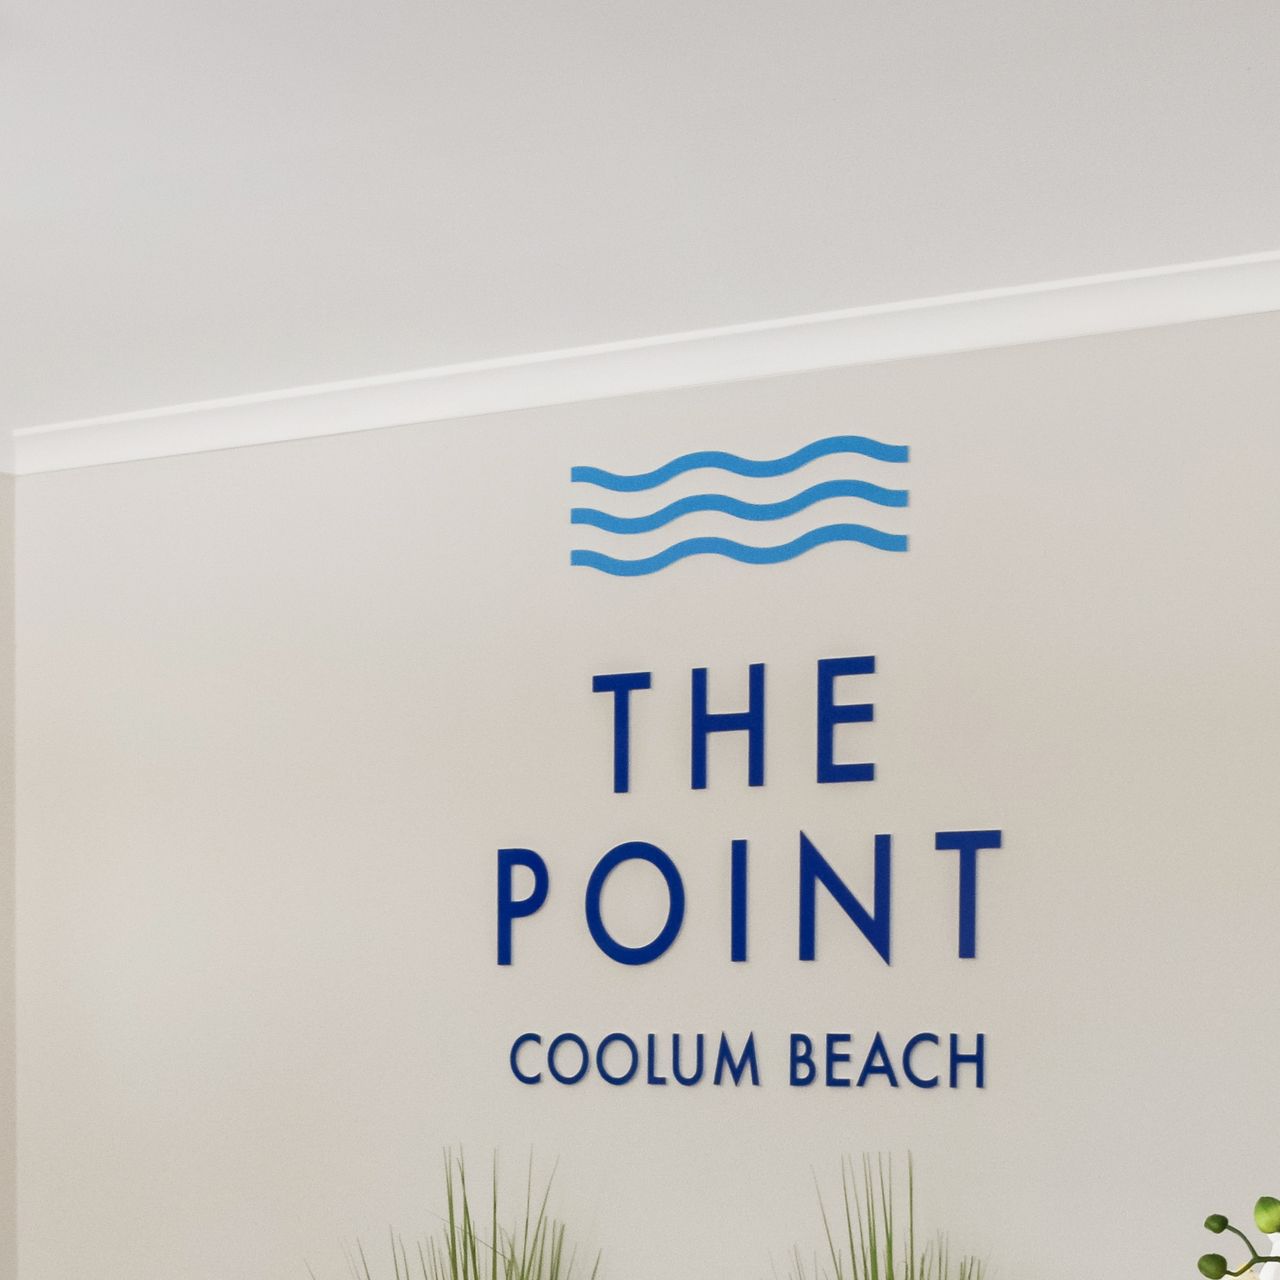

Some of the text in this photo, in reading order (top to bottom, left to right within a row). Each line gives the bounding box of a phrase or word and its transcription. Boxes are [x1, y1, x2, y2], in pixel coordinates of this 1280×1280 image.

[592, 654, 876, 793] THE
[495, 828, 1003, 966] POINT
[508, 1030, 986, 1088] COOLUM BEACH
